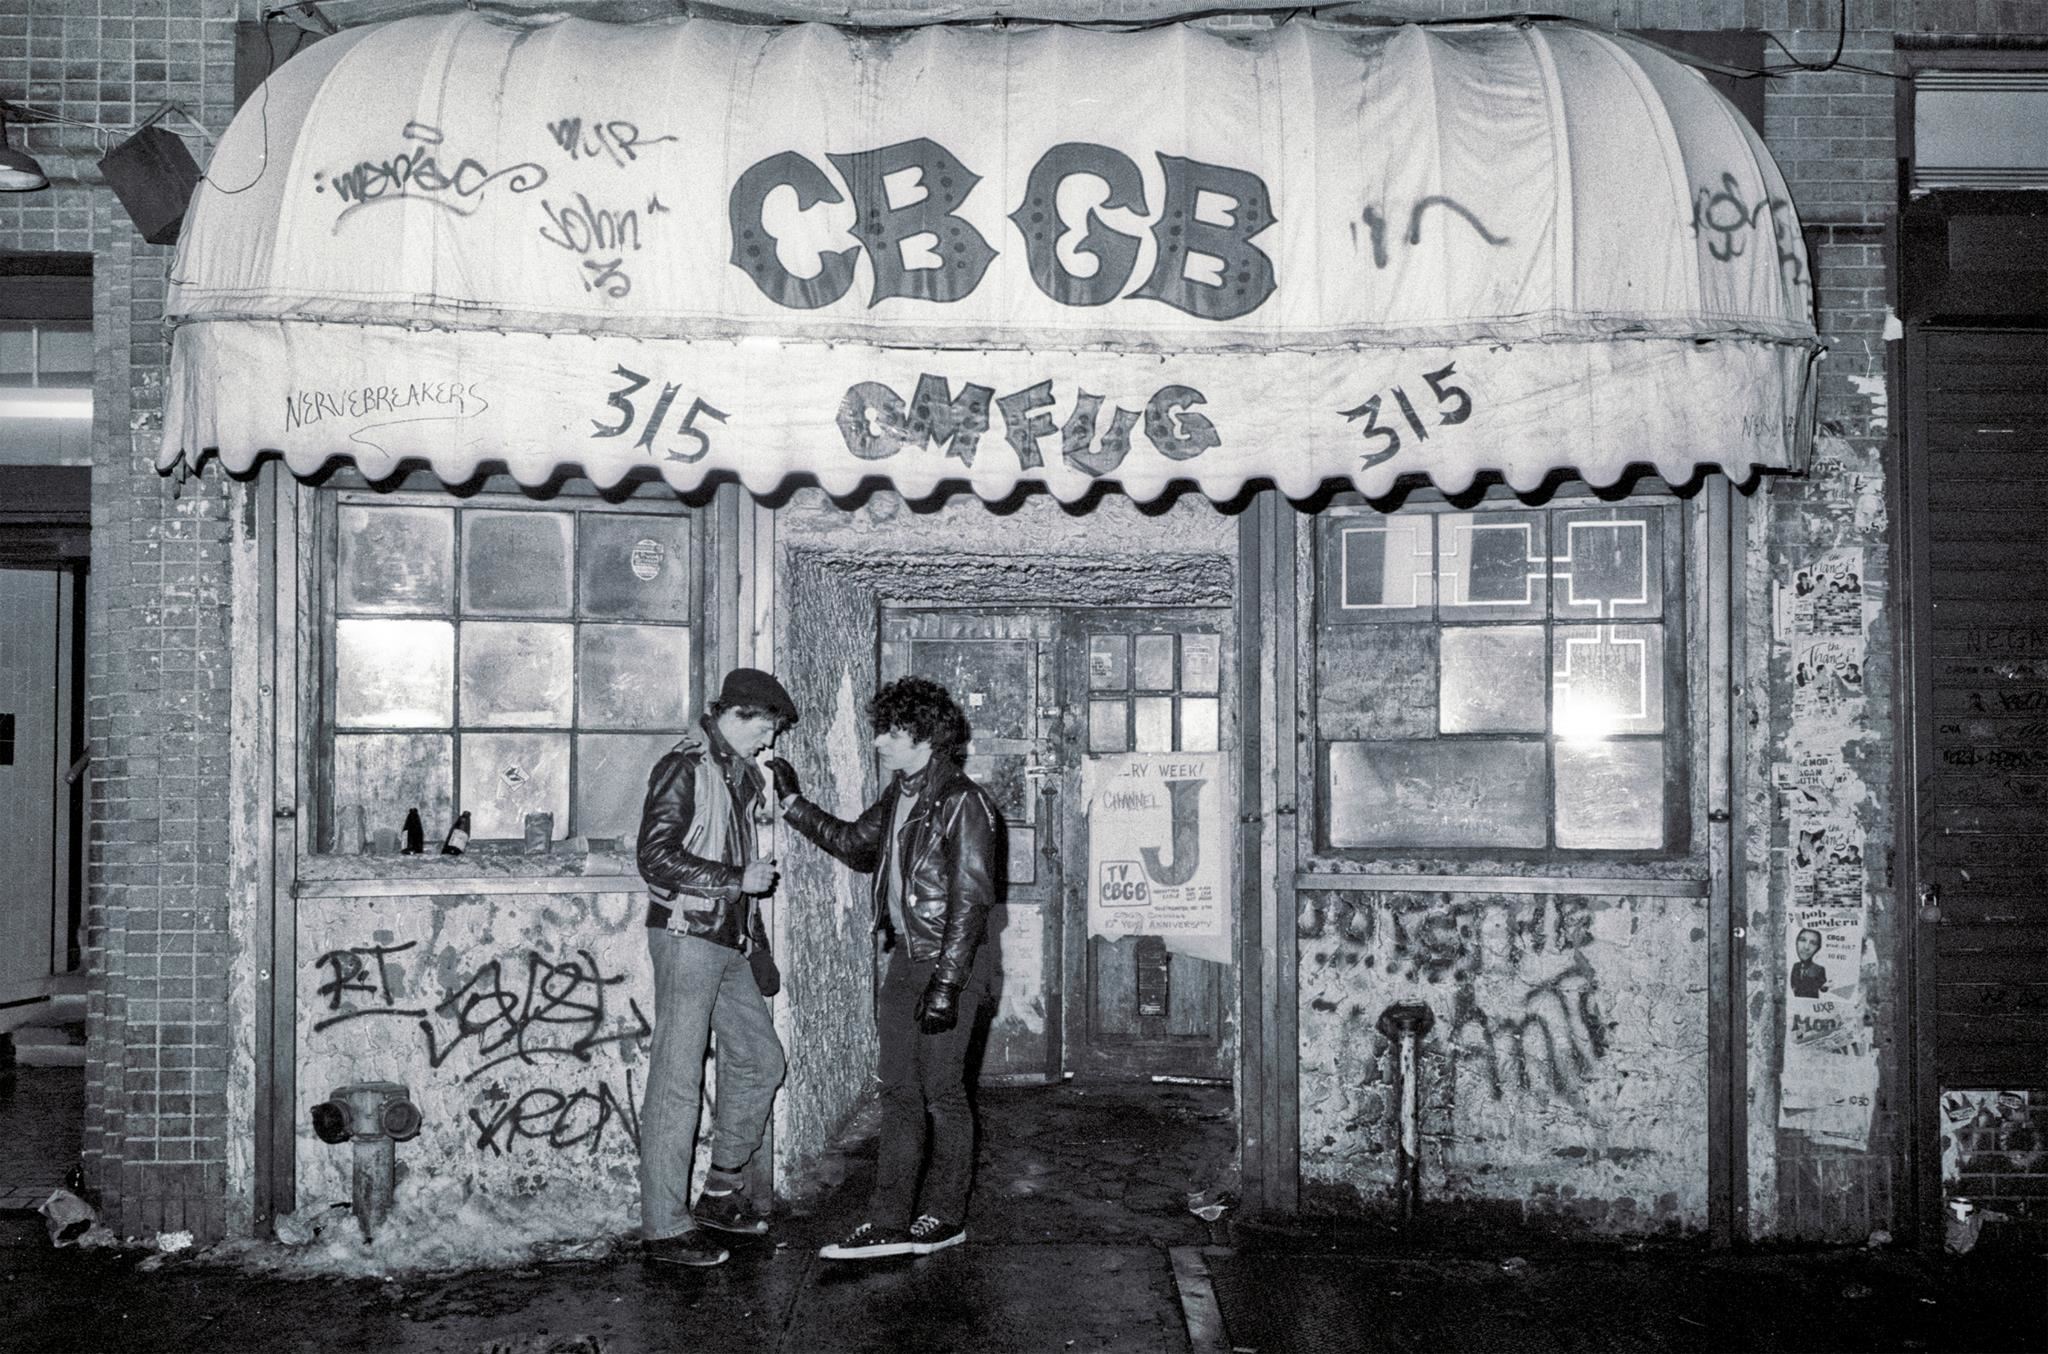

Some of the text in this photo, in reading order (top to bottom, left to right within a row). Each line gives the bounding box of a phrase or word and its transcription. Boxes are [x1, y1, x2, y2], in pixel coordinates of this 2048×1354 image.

[728, 137, 1278, 321] CBGB
[286, 382, 489, 432] NERVEBREAKERS
[590, 363, 730, 464] 315
[836, 373, 1222, 477] OMFUG
[1336, 361, 1473, 471] 315
[1159, 762, 1204, 778] WEEK!
[1139, 779, 1208, 887] J
[1102, 882, 1147, 901] CBGB
[1107, 864, 1129, 882] TV
[1801, 910, 1827, 920] bob
[1807, 918, 1858, 928] modern
